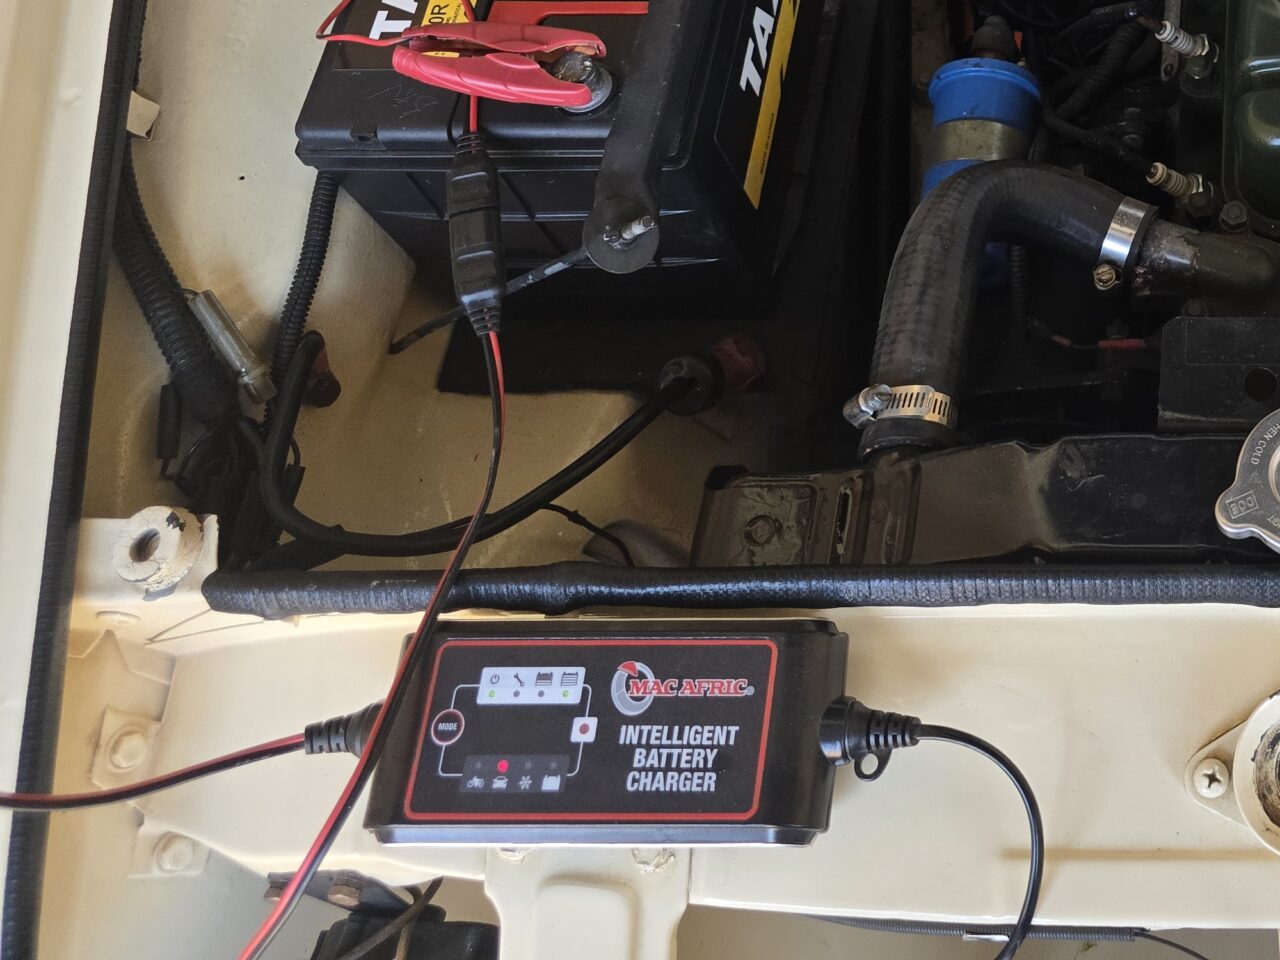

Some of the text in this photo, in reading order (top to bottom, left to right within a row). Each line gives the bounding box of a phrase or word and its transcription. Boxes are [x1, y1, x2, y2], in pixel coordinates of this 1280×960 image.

[1251, 440, 1267, 465] COLD
[628, 678, 678, 697] MAC
[437, 722, 458, 731] MODE
[619, 725, 740, 745] INTELLIGENT
[633, 748, 718, 768] BATTERY
[626, 771, 717, 792] CHARGER
